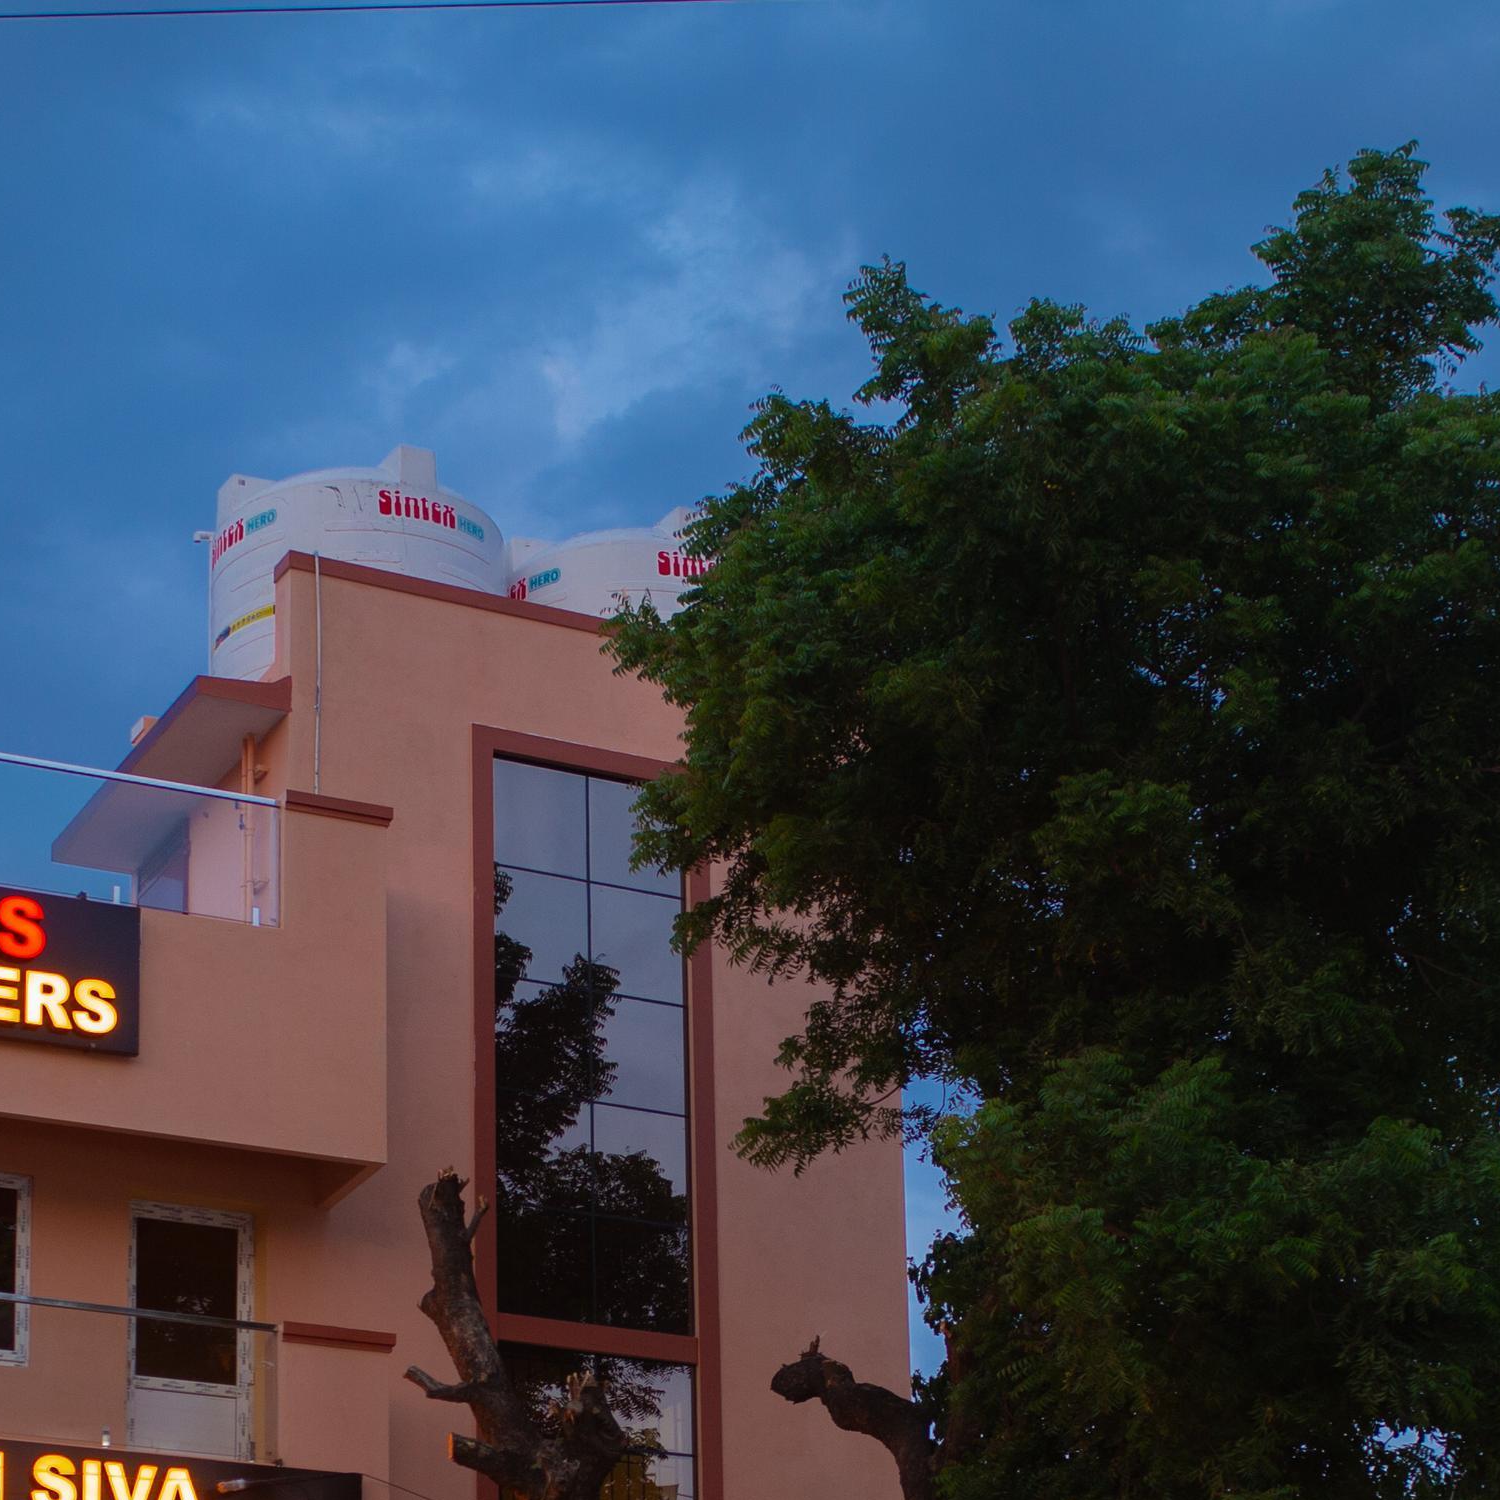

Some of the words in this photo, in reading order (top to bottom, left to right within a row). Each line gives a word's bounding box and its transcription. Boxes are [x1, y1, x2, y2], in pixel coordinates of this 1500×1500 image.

[378, 489, 456, 529] Sintex
[459, 517, 484, 540] HERO
[530, 569, 560, 590] HERO
